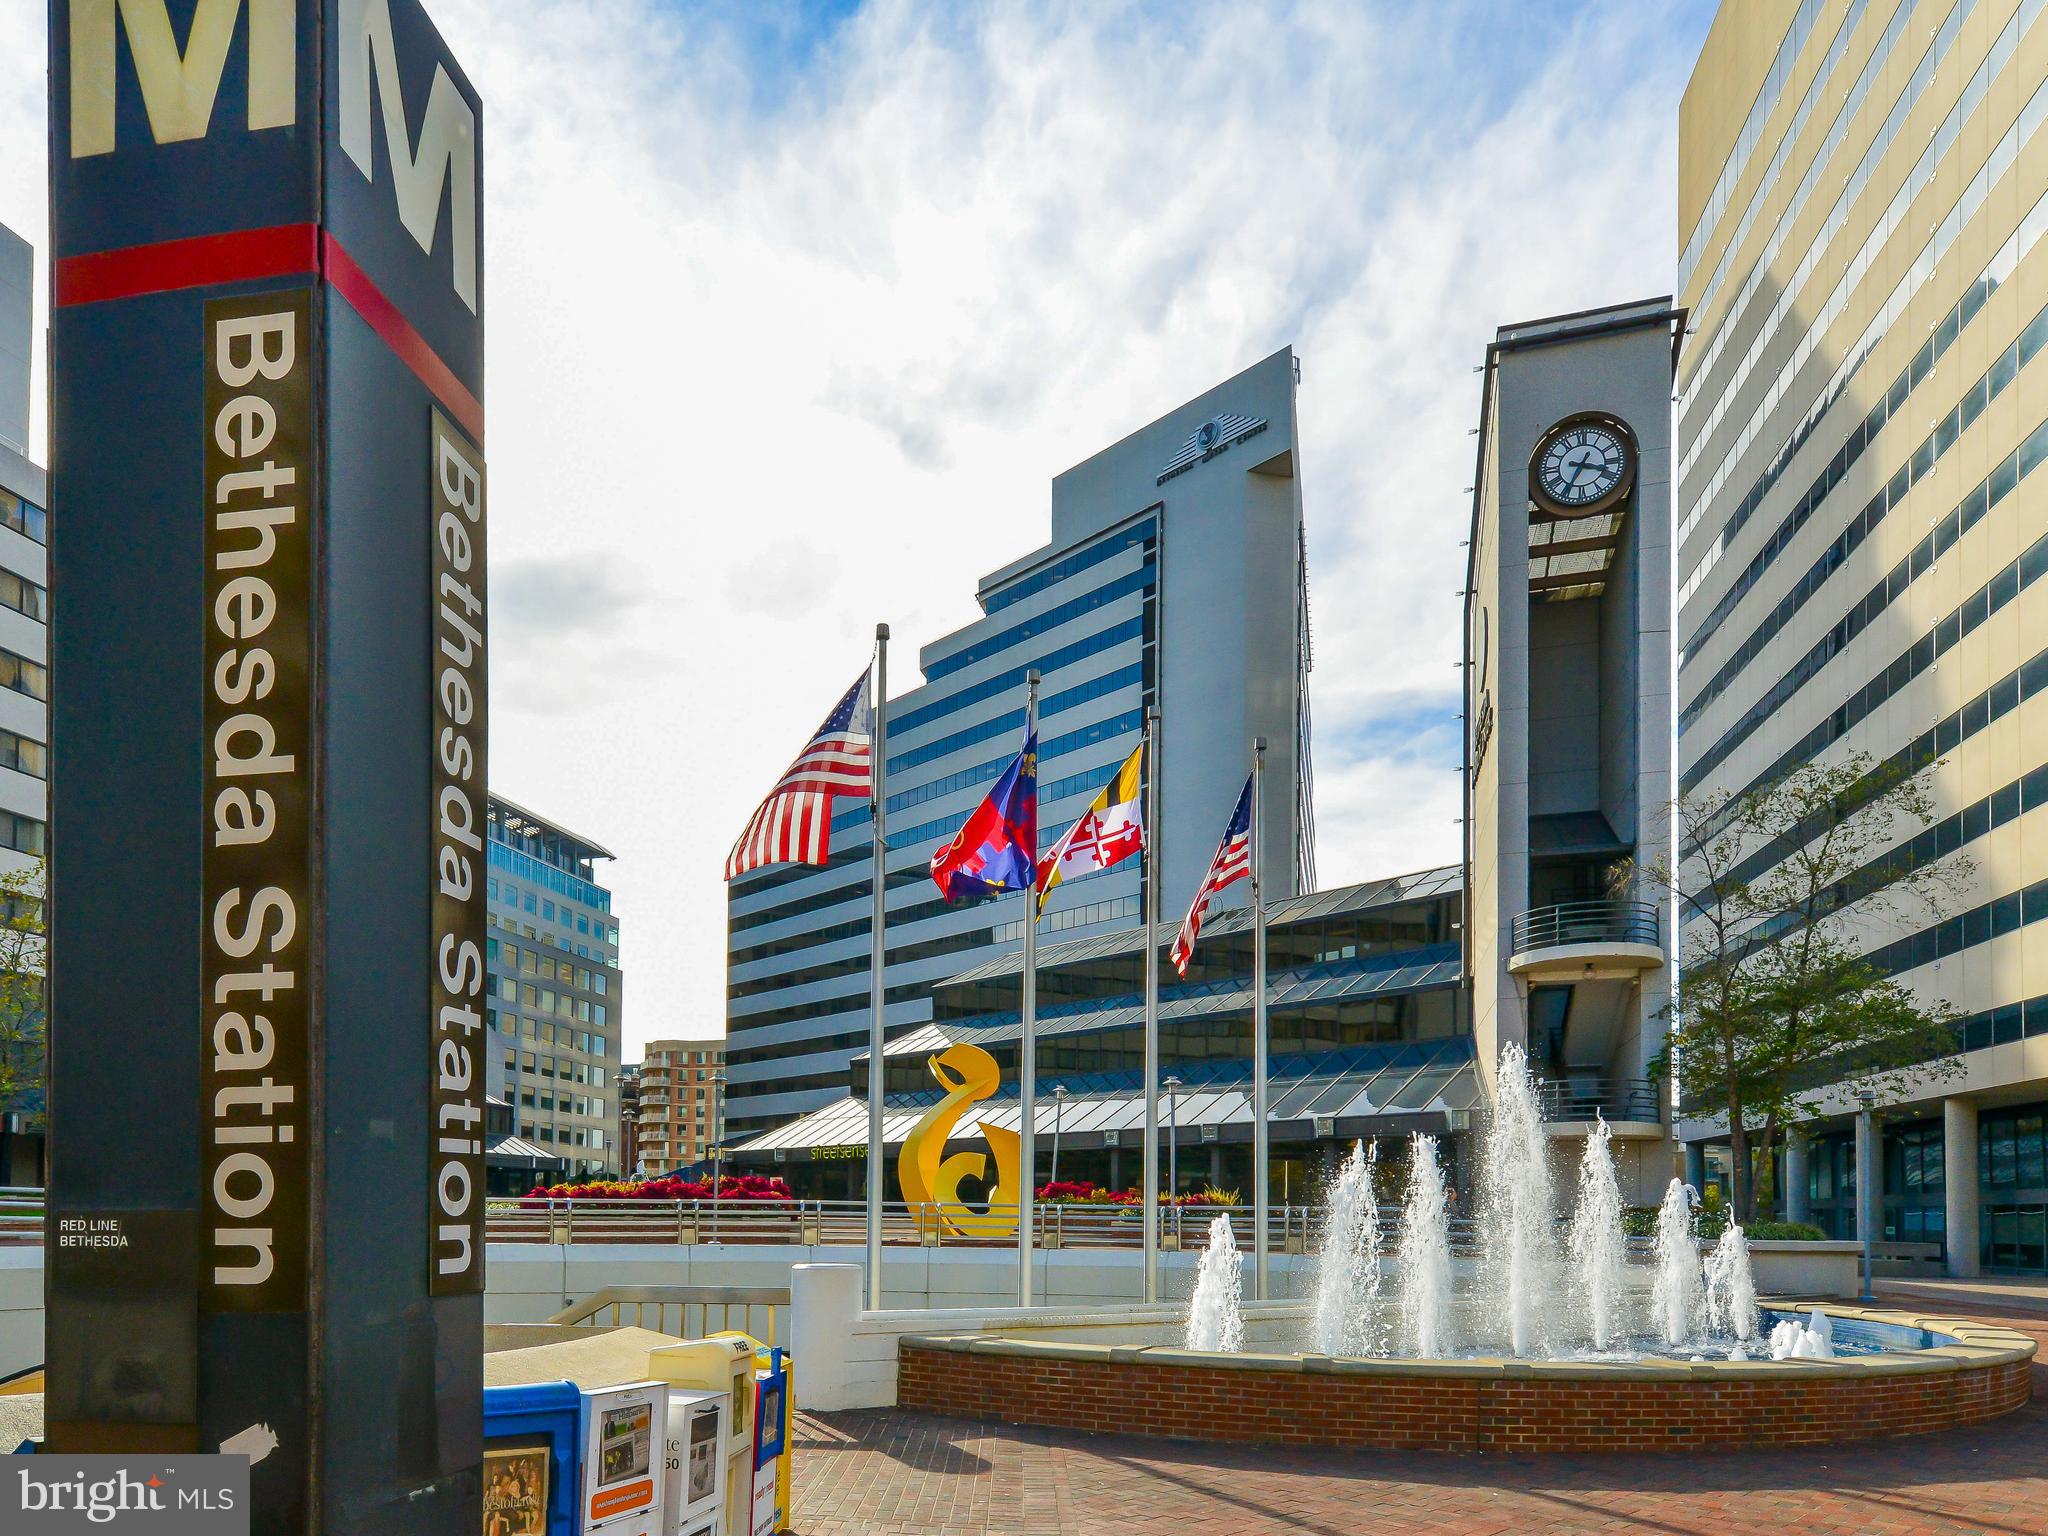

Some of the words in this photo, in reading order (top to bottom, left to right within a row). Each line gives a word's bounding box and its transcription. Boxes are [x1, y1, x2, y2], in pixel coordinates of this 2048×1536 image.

[70, 0, 296, 159] M
[339, 0, 477, 318] M
[214, 311, 296, 847] Bethesda
[438, 434, 482, 902] Bethesda
[59, 1235, 129, 1247] BETHESDA
[60, 1219, 87, 1231] RED
[90, 1219, 118, 1231] LINE
[213, 886, 296, 1285] Station
[438, 933, 482, 1275] Station
[732, 1340, 750, 1353] FREE
